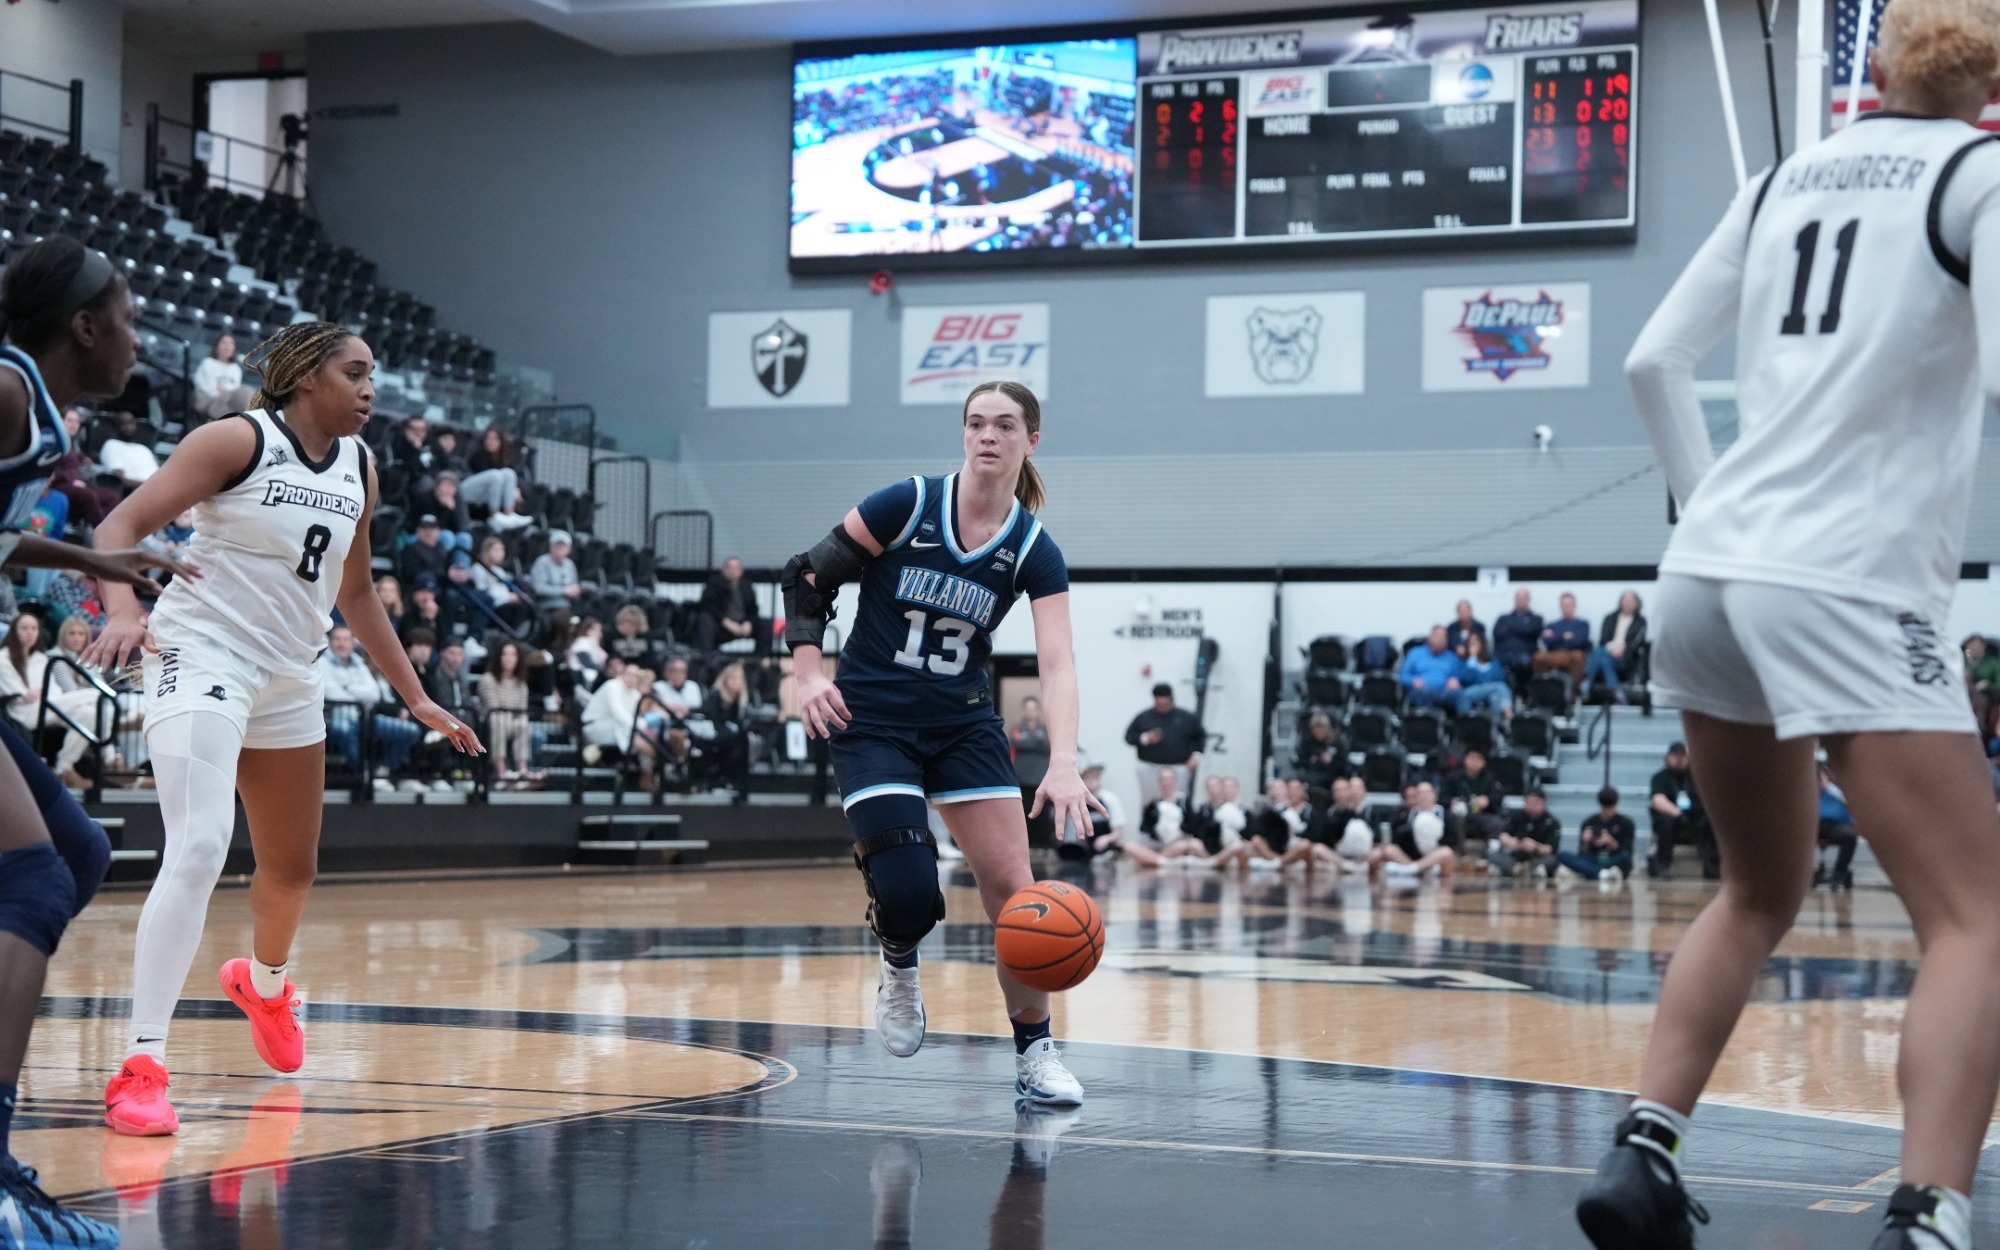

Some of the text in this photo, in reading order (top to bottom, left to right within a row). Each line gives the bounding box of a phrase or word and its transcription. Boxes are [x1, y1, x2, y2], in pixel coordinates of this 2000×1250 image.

[1485, 14, 1582, 48] FRIARS
[1157, 32, 1302, 74] PROVIDENCE
[1534, 80, 1557, 100] 11
[1607, 74, 1630, 96] 19
[1189, 101, 1204, 123] 2
[1443, 104, 1499, 127] GUEST
[1533, 98, 1629, 124] 13 0 20
[1221, 122, 1236, 144] 2
[1263, 115, 1311, 135] HOME
[1358, 118, 1399, 135] PERIOD
[1249, 177, 1287, 193] FOULS
[1468, 166, 1507, 182] FOULS
[1779, 217, 1860, 335] 11
[931, 313, 1023, 342] BIG
[916, 342, 1046, 370] EAST
[296, 523, 332, 583] 8
[896, 566, 998, 628] VILLANOVA
[1161, 608, 1203, 622] MEN'S
[894, 609, 977, 676] 13
[1130, 624, 1204, 639] RESTROOM
